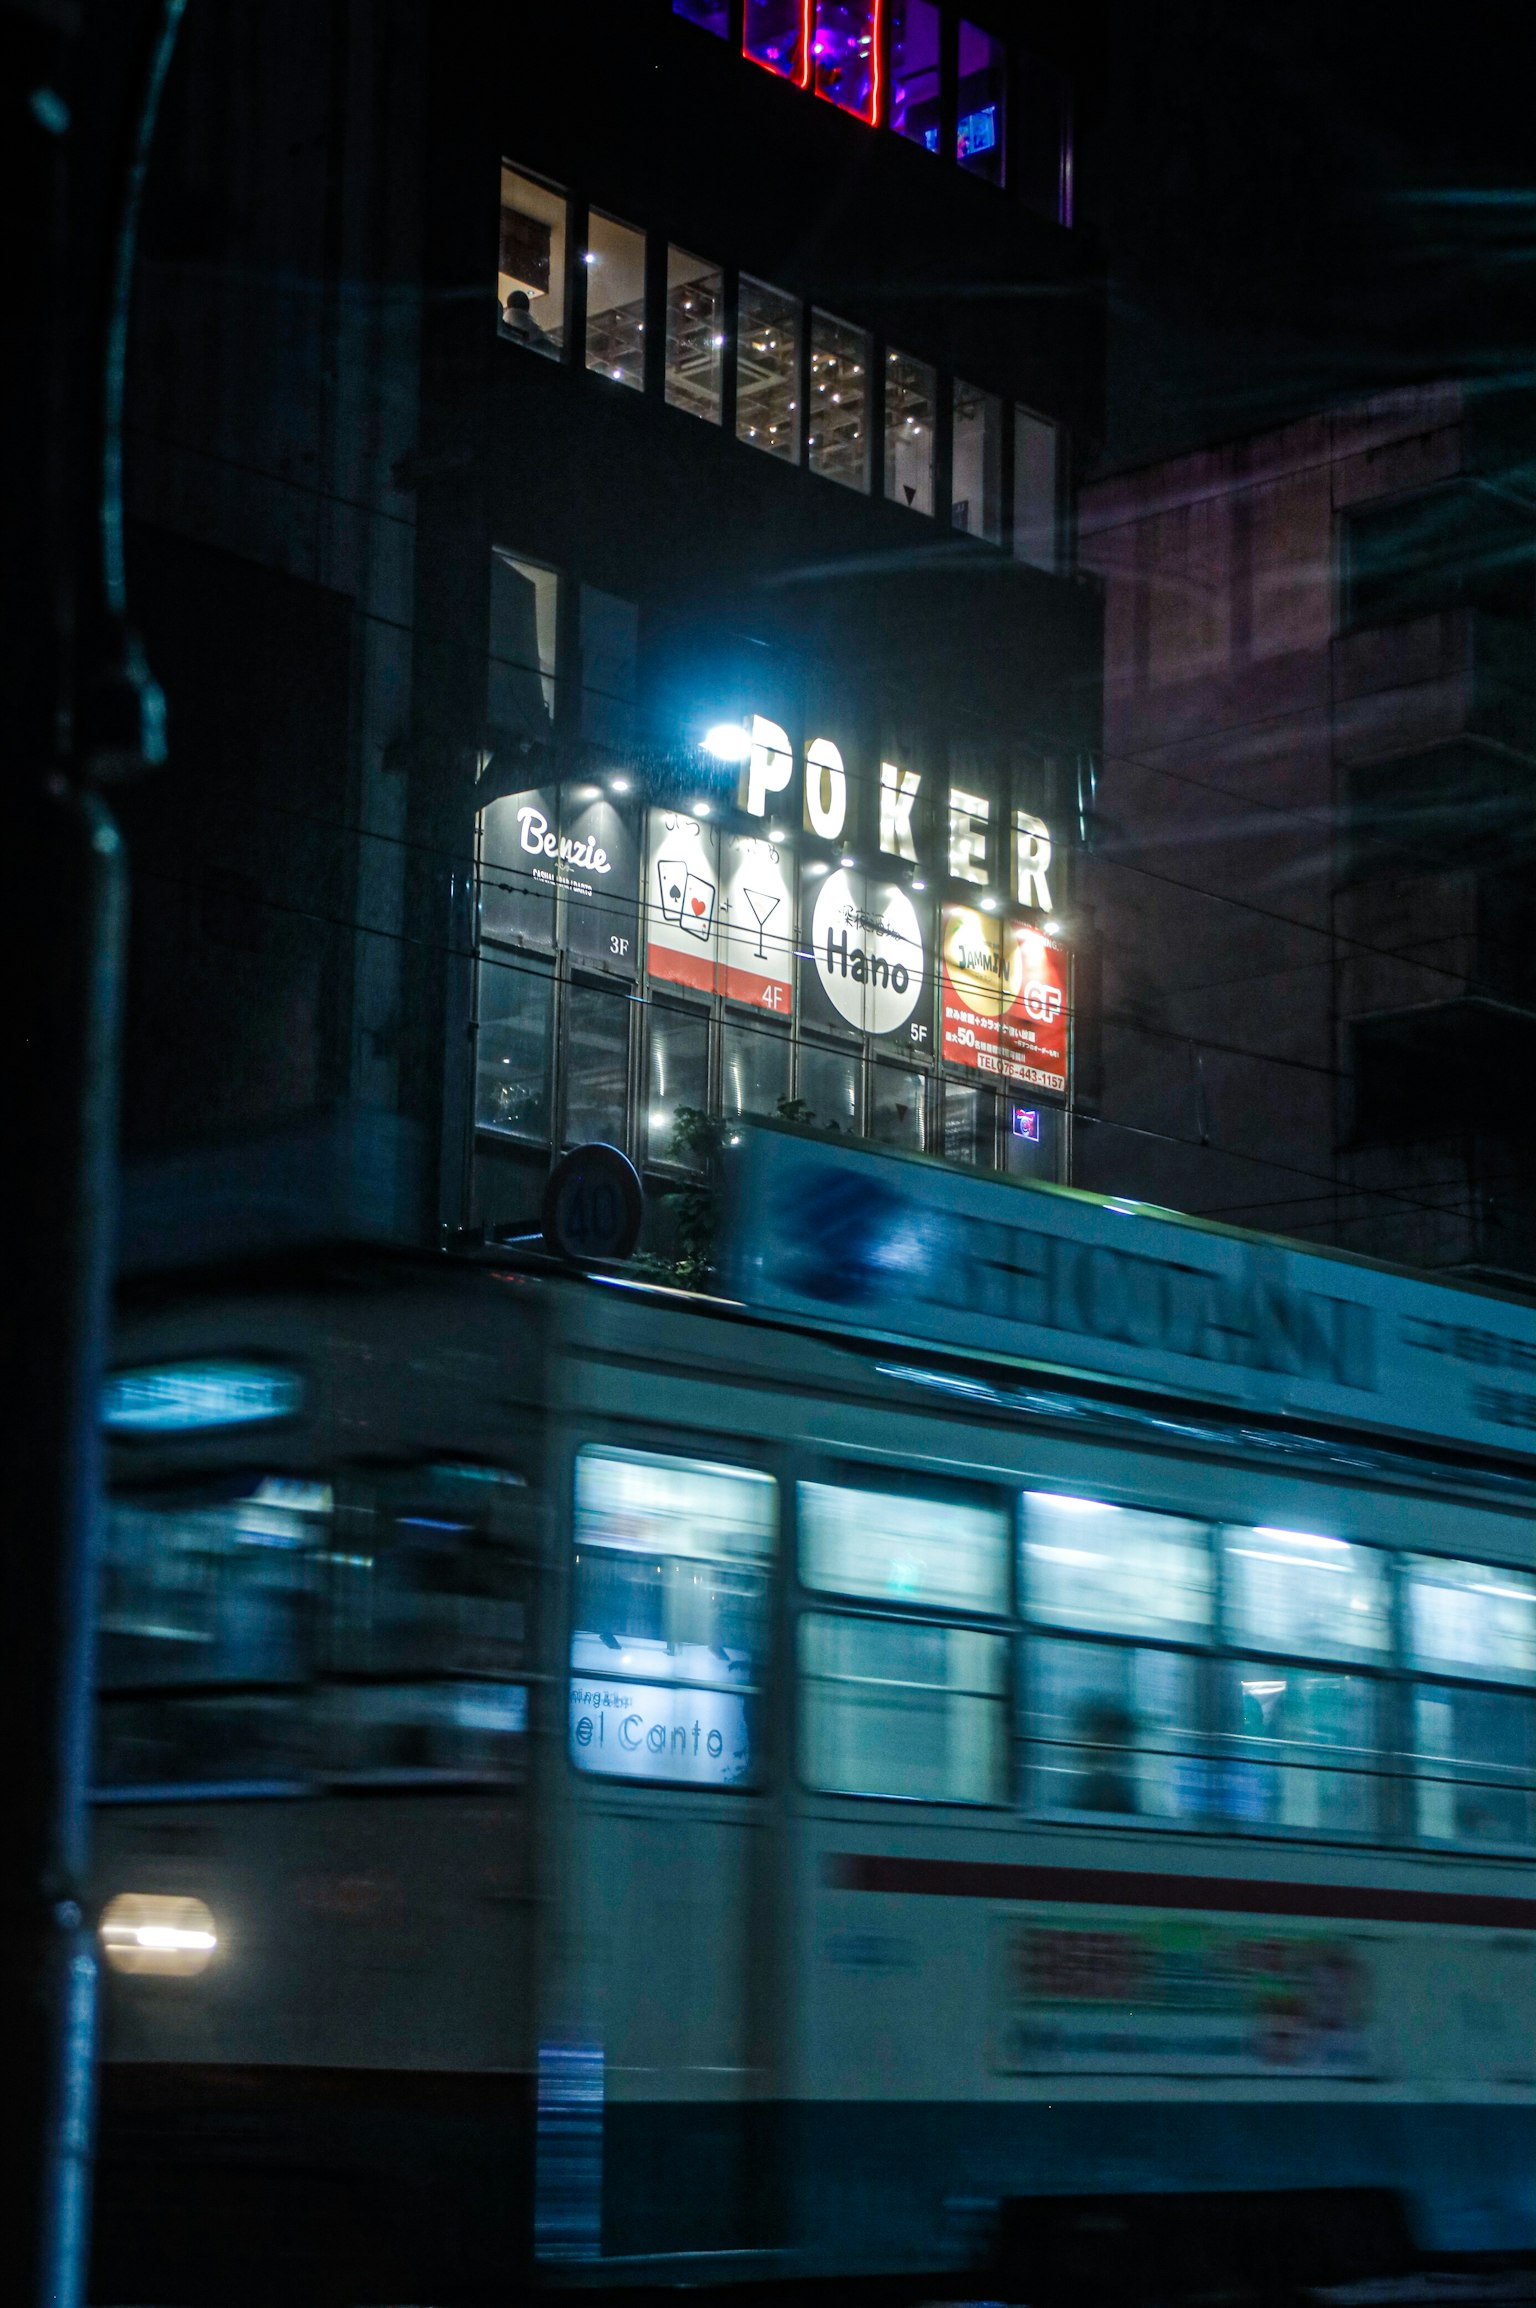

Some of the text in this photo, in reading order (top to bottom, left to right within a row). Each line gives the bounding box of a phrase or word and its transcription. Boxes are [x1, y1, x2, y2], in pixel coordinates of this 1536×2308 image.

[740, 714, 1054, 913] POKER
[517, 807, 612, 874] Benzie
[609, 935, 629, 957] 3F
[827, 926, 909, 995] Hano
[958, 945, 1010, 982] JAMMIN
[761, 984, 783, 1010] 4F
[1023, 980, 1062, 1024] 6F
[910, 1022, 928, 1043] 5F
[575, 1711, 723, 1758] el Canto
